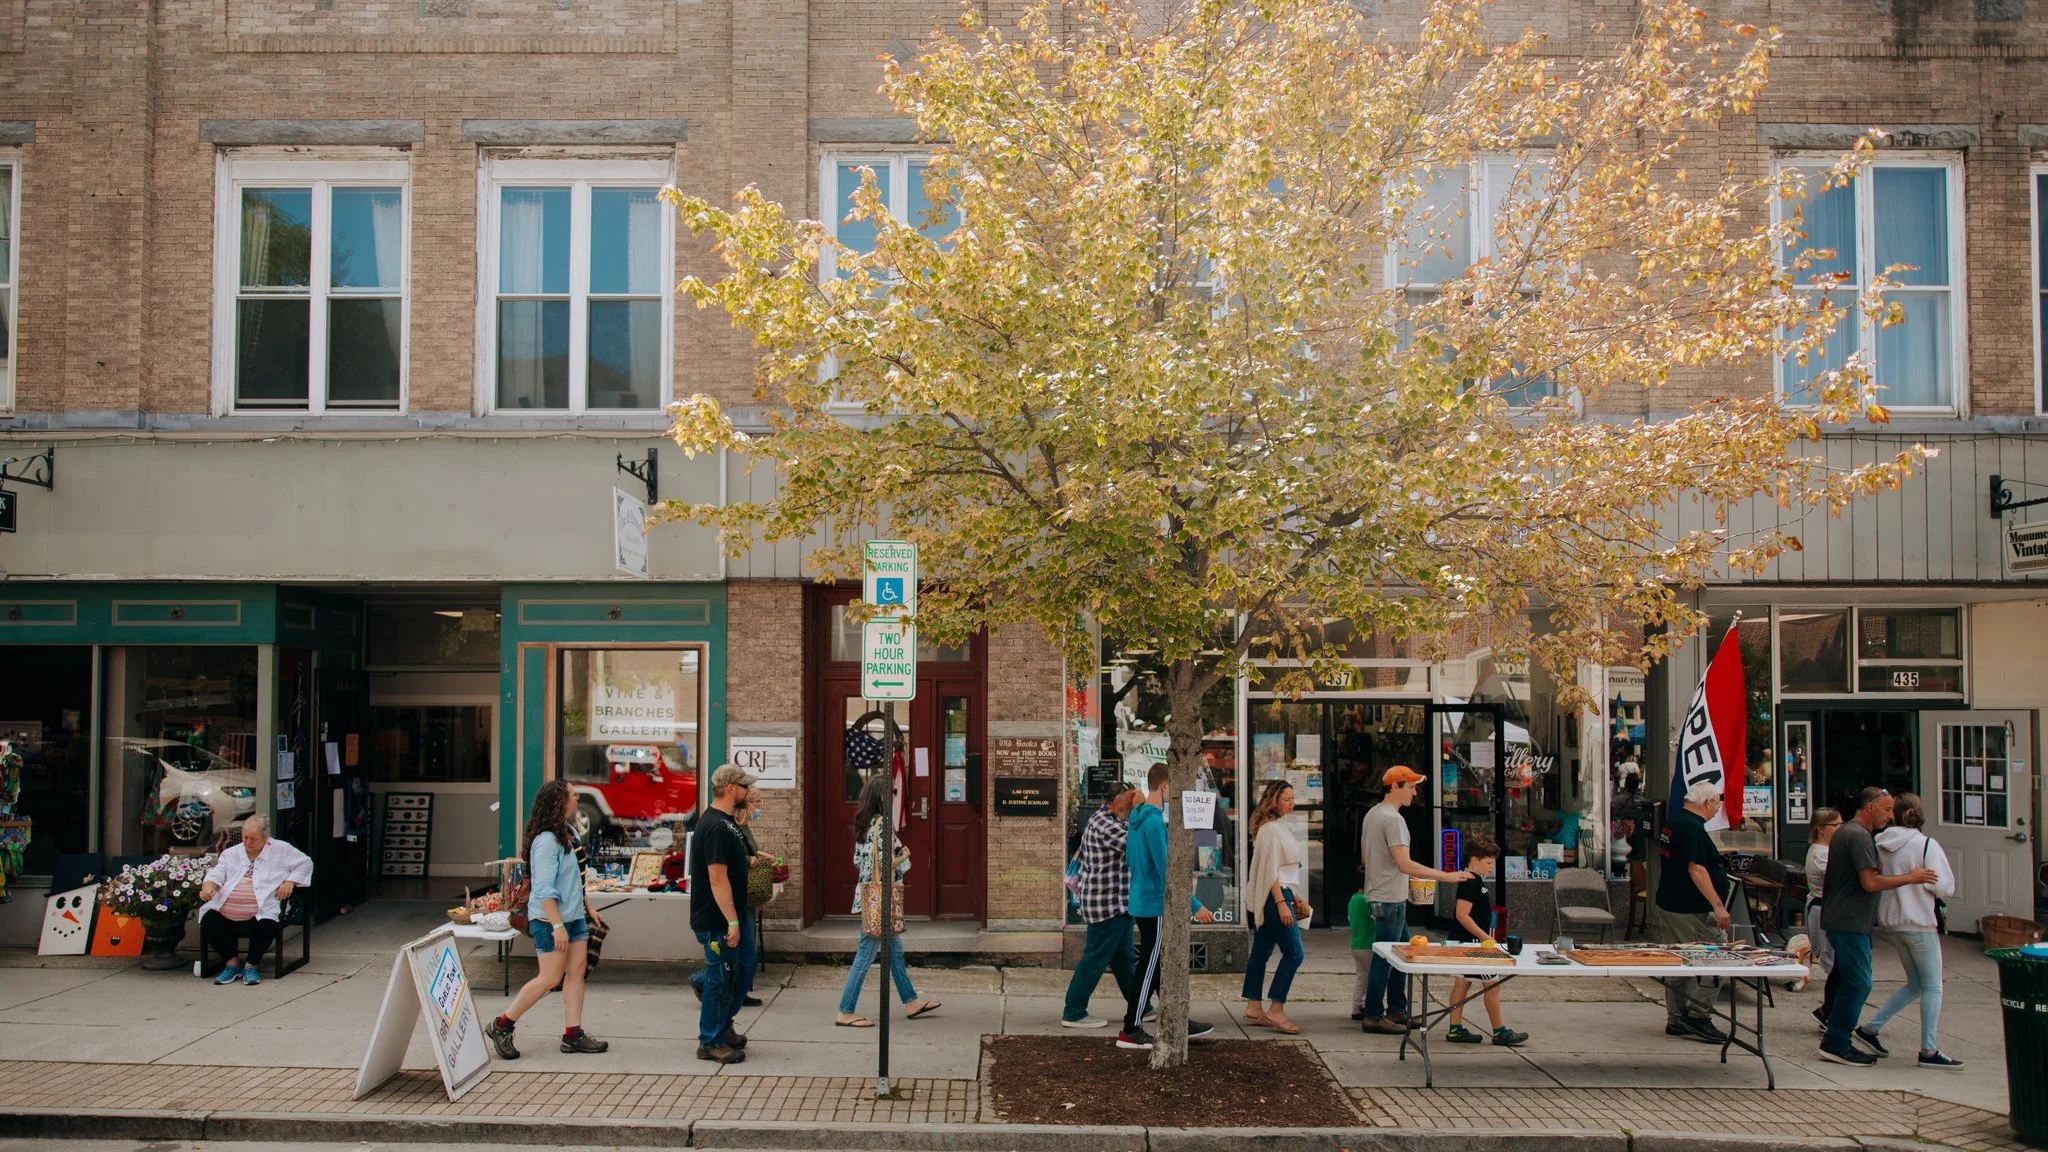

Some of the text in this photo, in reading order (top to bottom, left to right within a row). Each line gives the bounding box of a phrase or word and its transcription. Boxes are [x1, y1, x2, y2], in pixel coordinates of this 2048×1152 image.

[867, 548, 913, 559] RESERVED
[878, 632, 901, 645] TWO
[874, 647, 904, 660] HOUR
[866, 662, 912, 676] PARKING
[1894, 672, 1918, 686] 435
[605, 687, 663, 700] VINE &
[595, 705, 674, 718] BRANCHES
[599, 724, 670, 736] GALLERY
[734, 749, 767, 773] CRJ
[1504, 747, 1555, 773] allery
[448, 1002, 472, 1069] GALLERY
